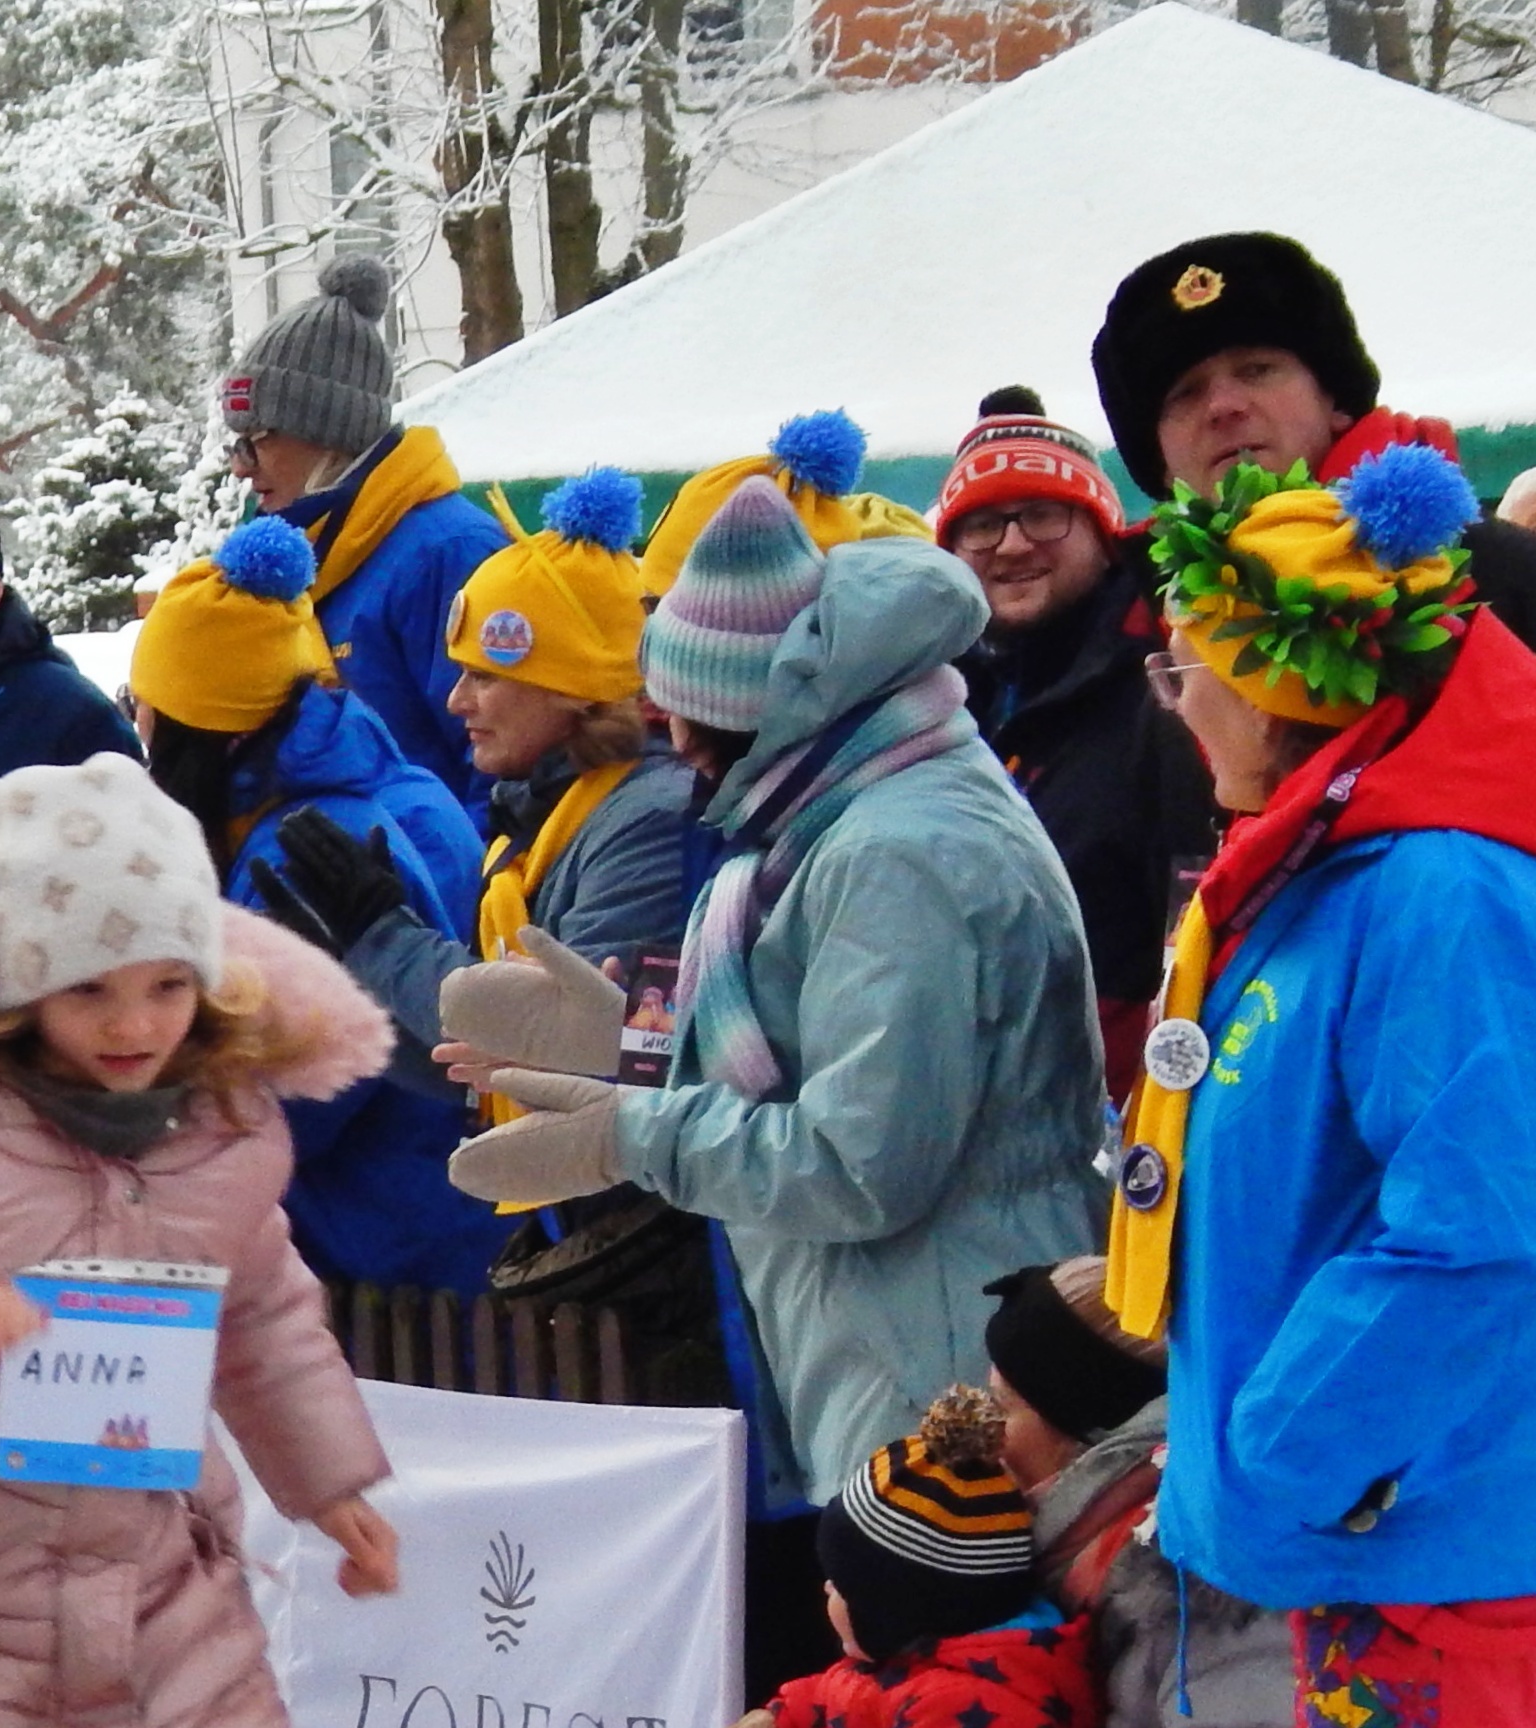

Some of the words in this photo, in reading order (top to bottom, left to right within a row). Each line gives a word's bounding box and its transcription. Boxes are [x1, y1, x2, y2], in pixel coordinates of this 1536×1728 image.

[941, 452, 1113, 518] Guan
[641, 1035, 672, 1051] WIO
[20, 1348, 147, 1385] ANNA
